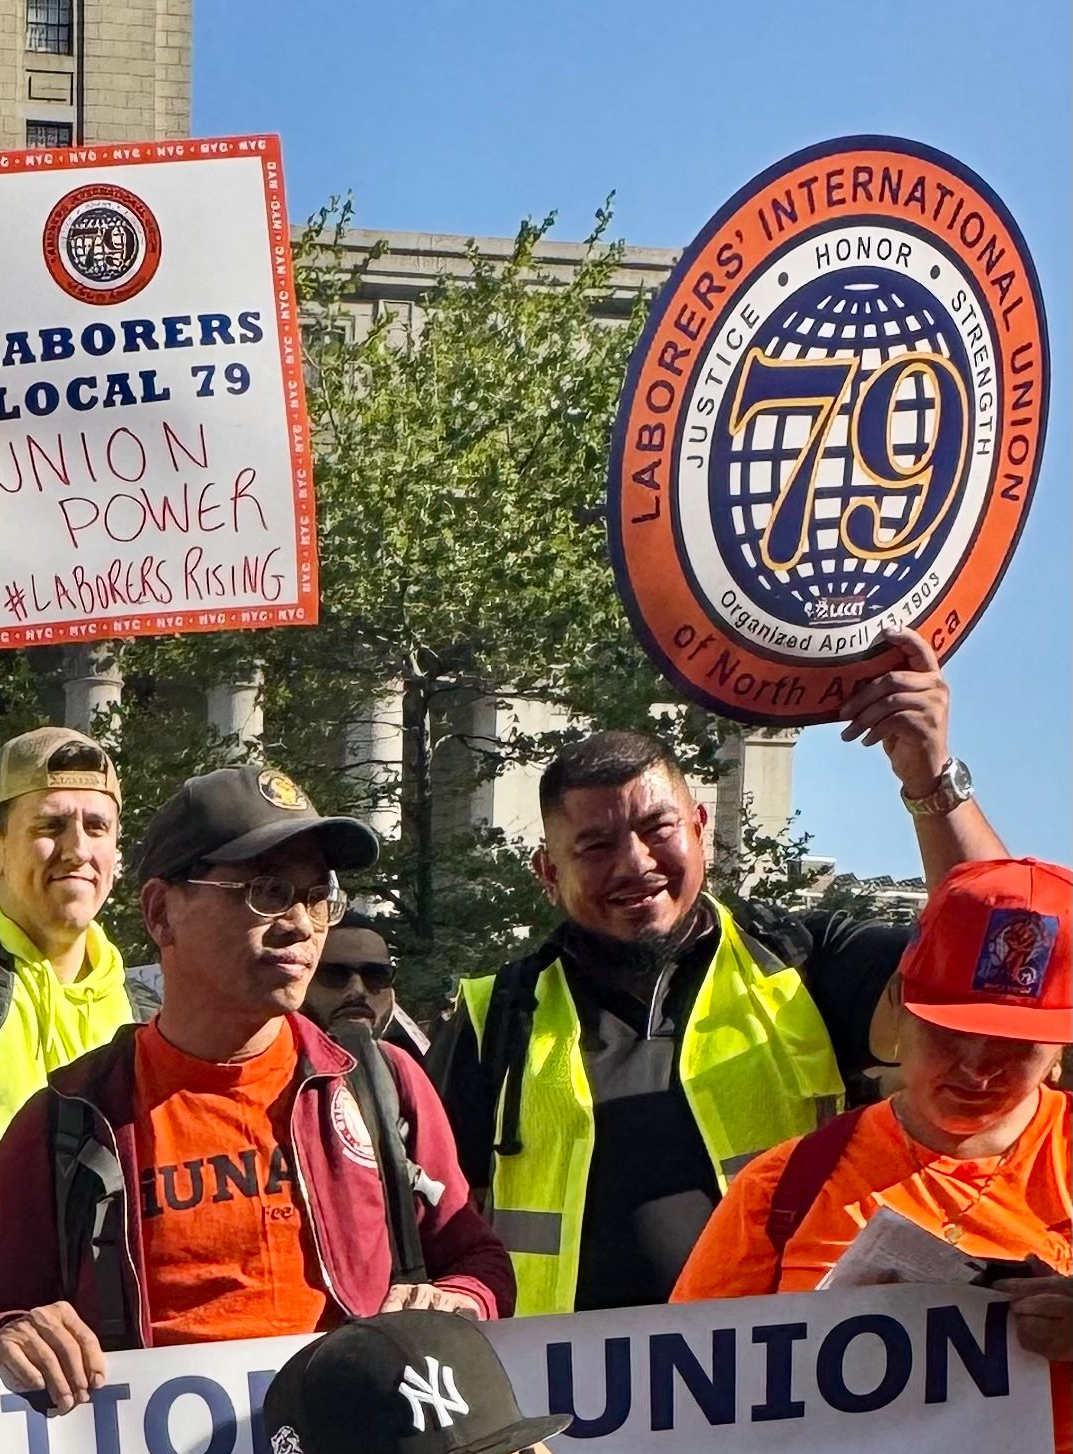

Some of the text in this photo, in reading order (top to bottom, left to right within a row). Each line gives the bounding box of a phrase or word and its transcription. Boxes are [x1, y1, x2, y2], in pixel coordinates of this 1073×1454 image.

[26, 154, 53, 166] NYC
[70, 150, 96, 163] NYC
[114, 148, 140, 160] NYC
[157, 145, 184, 157] NYC
[200, 142, 228, 153] NYC
[239, 140, 266, 151] NYC
[192, 362, 251, 398] 79
[267, 161, 311, 593] NYC NYC NYC NYC NYC NYC NYC NYC NYC NYC
[631, 165, 1034, 524] LABORERS' INTERNATIONAL UNION
[686, 236, 994, 470] JUSTICE HONOR STRENGTH
[729, 347, 969, 572] 79
[59, 467, 269, 549] POWER
[4, 546, 285, 621] #LABORERS RISING
[26, 629, 53, 641] NYC
[70, 624, 96, 636] NYC
[113, 619, 140, 631] NYC
[157, 615, 183, 628] NYC
[199, 613, 225, 625] NYC
[241, 611, 268, 623] NYC
[278, 608, 304, 620] NYC
[721, 589, 811, 651] Organized
[818, 632, 870, 655] April
[673, 623, 710, 661] of
[707, 662, 807, 707] North
[398, 1355, 470, 1432] NY
[546, 1300, 1011, 1439] UNION
